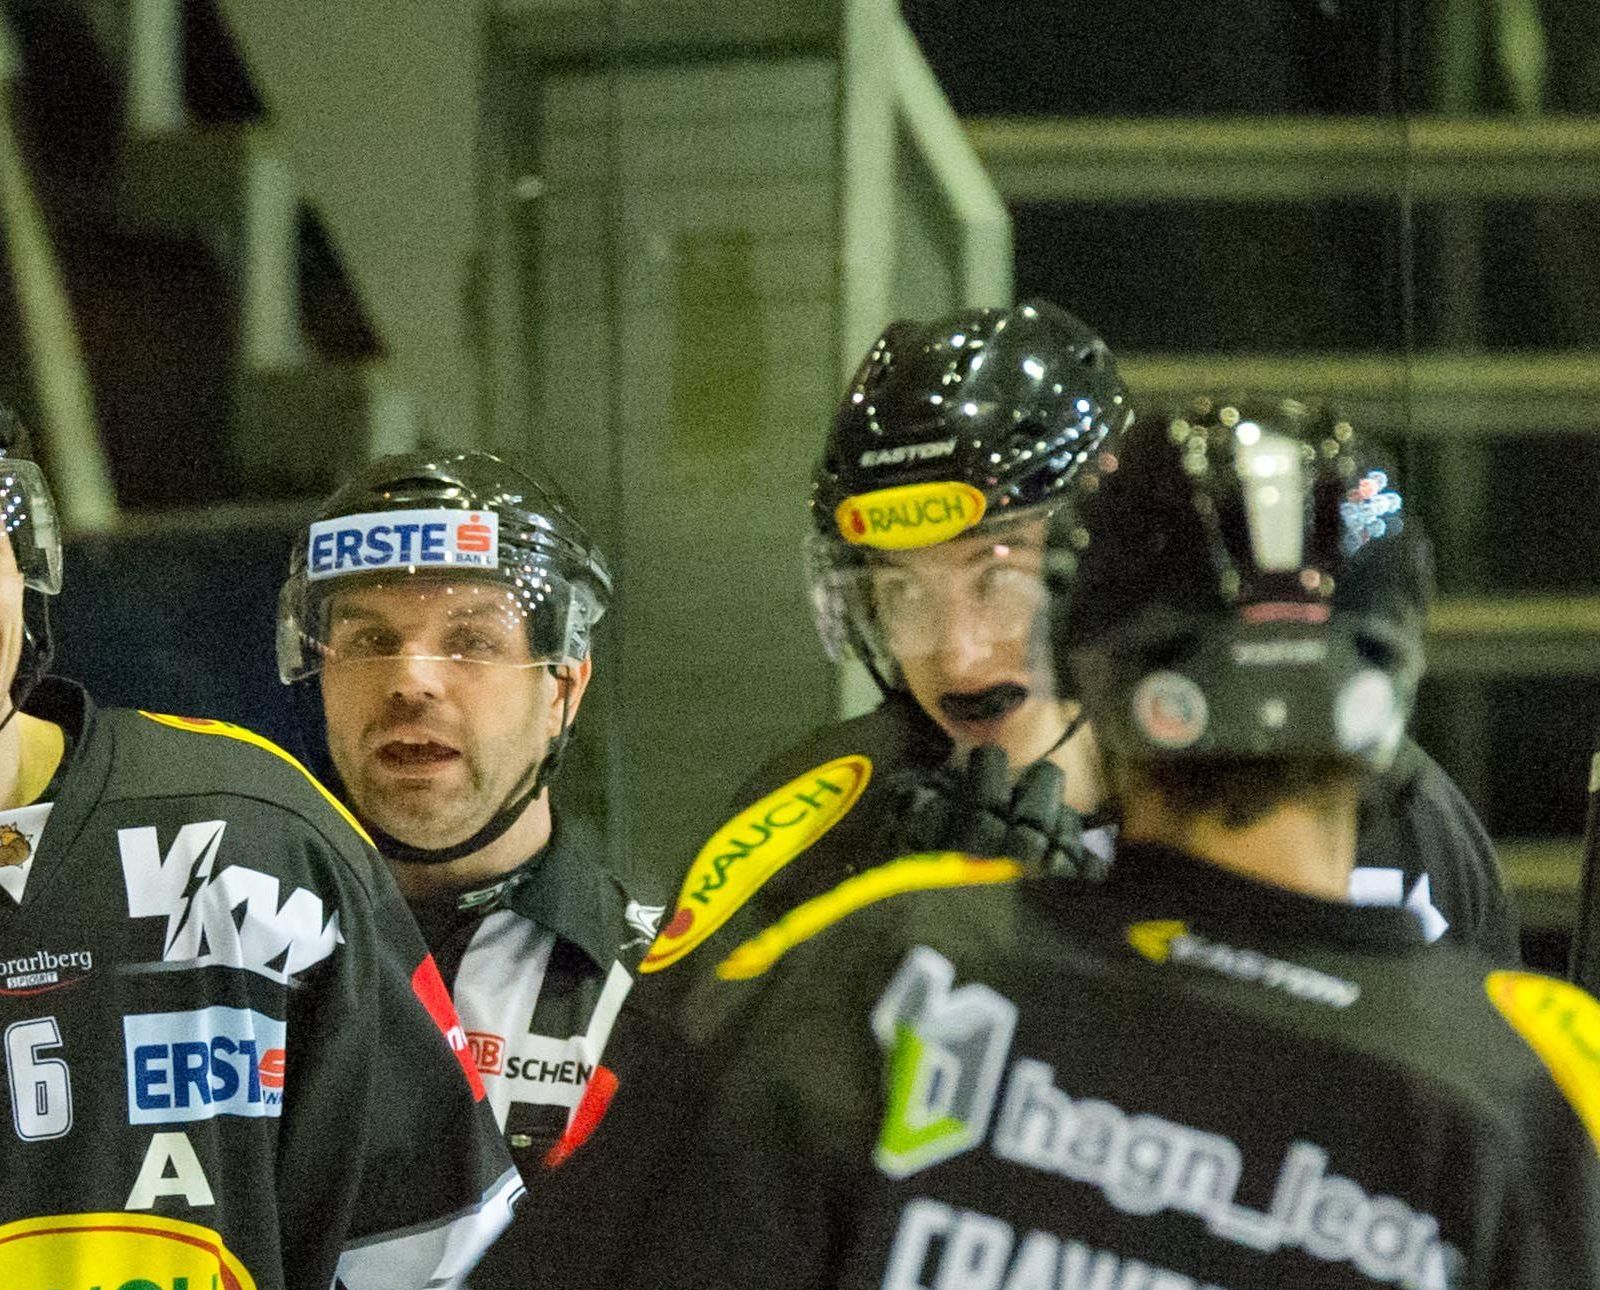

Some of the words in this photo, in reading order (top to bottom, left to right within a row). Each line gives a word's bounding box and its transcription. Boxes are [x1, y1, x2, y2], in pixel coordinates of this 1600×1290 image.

[312, 523, 447, 572] ERSTE
[868, 497, 966, 534] RAUCH
[690, 778, 843, 904] RAUCH
[5, 1016, 73, 1141] 6
[134, 1035, 262, 1111] ERST
[124, 1132, 216, 1211] A
